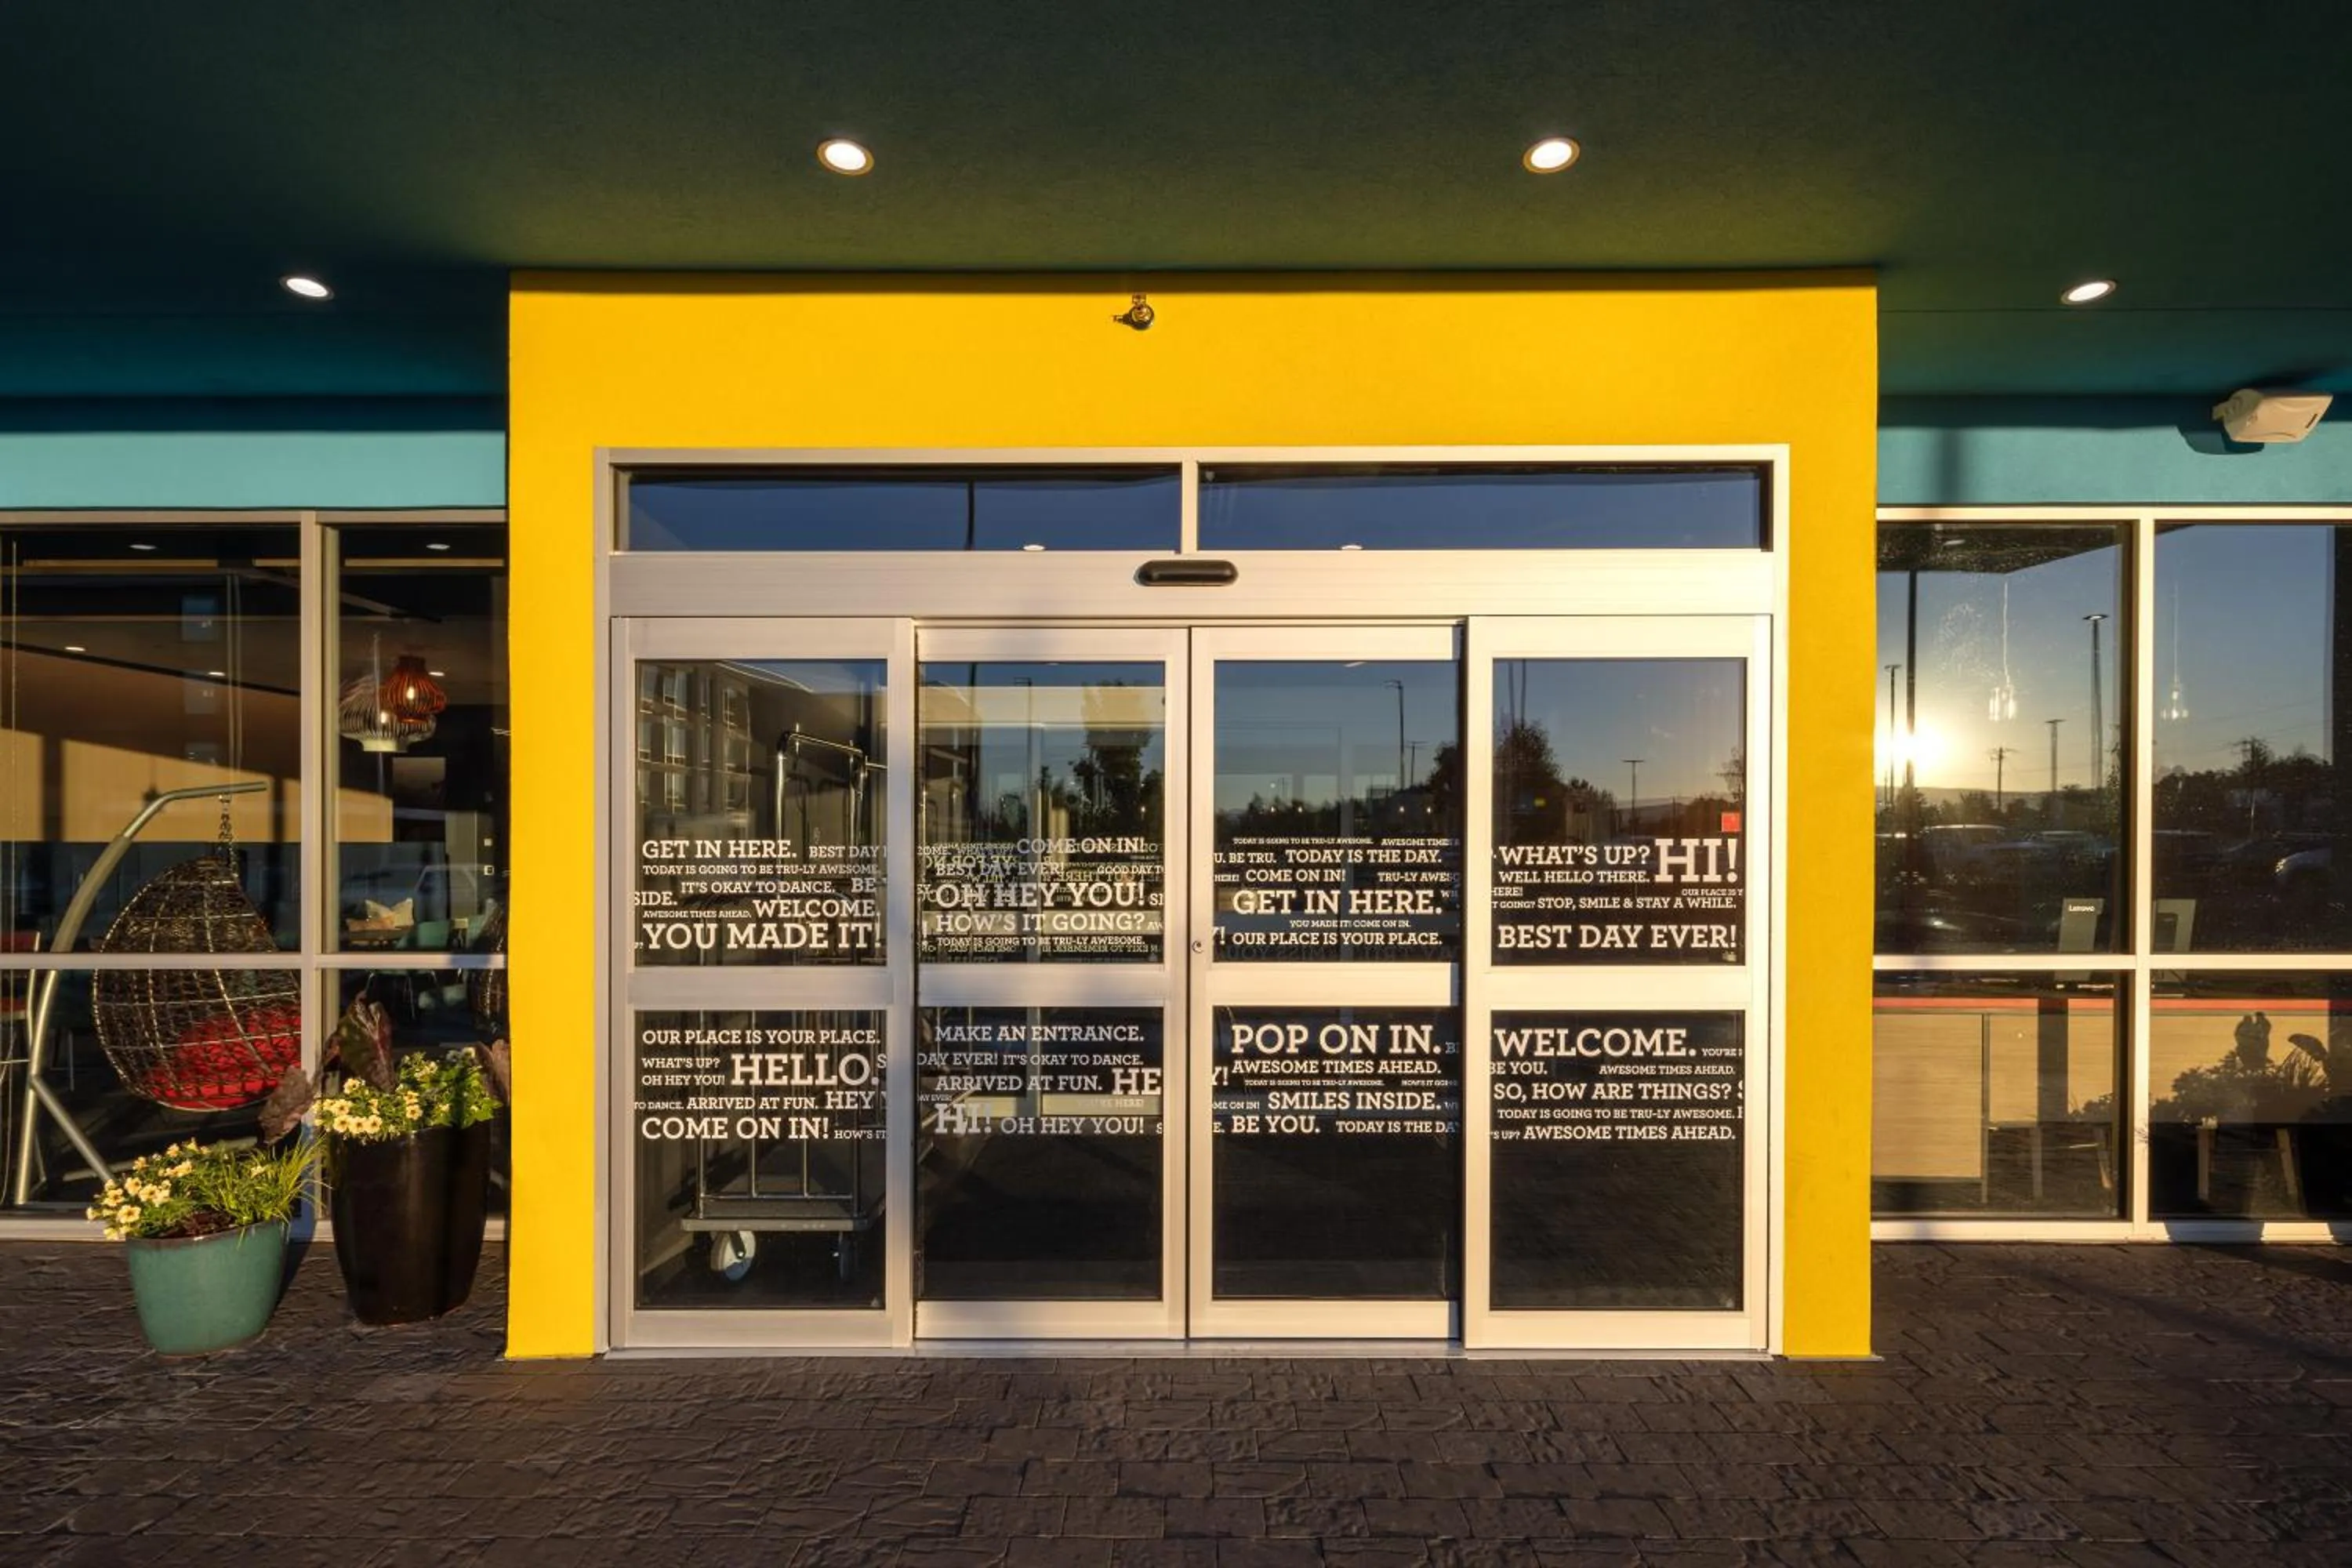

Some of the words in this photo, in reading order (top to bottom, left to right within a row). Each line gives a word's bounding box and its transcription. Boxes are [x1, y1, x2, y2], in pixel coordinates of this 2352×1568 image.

[642, 840, 689, 858] GET
[695, 840, 722, 858] IN
[728, 840, 797, 858] HERE.
[808, 846, 845, 858] BEST
[849, 846, 879, 858] DAY
[1017, 838, 1076, 853] COME
[1081, 838, 1112, 853] ON
[1116, 837, 1145, 853] IN!
[1229, 852, 1245, 863] BE
[1247, 852, 1277, 863] TRU.
[1285, 849, 1345, 863] TODAY
[1347, 849, 1363, 863] IS
[1367, 849, 1401, 863] THE
[1404, 849, 1442, 863] DAY.
[1498, 845, 1598, 866] WHAT'S
[1603, 845, 1650, 866] UP?
[1654, 838, 1738, 883] HI!
[643, 865, 684, 875] TODAY
[685, 865, 696, 875] IS
[699, 865, 738, 875] GOING
[740, 865, 757, 875] TO
[759, 865, 774, 875] BE
[775, 865, 817, 875] TRU-LY
[935, 863, 972, 876] BEST
[980, 862, 1012, 876] DAY
[1018, 862, 1064, 875] EVER!
[1131, 866, 1152, 874] DAY
[1246, 869, 1293, 882] COME
[1296, 869, 1320, 882] ON
[1323, 869, 1345, 882] IN!
[1377, 872, 1418, 882] TRU-LY
[1498, 871, 1541, 884] WELL
[1544, 871, 1594, 884] HELLO
[1596, 871, 1650, 884] THERE.
[681, 880, 708, 893] IT'S
[711, 880, 752, 893] OKAY
[755, 880, 777, 893] TO
[778, 880, 836, 893] DANCE.
[851, 877, 877, 893] BE
[935, 884, 985, 908] OH
[993, 882, 1060, 907] HEY
[1067, 882, 1145, 906] YOU!
[1232, 890, 1297, 915] GET
[1304, 890, 1341, 915] IN
[1348, 890, 1443, 915] HERE.
[753, 899, 881, 917] WELCOME.
[1537, 897, 1577, 911] STOP,
[1578, 897, 1621, 909] SMILE
[1623, 897, 1633, 909] &
[1636, 897, 1671, 909] STAY
[1673, 897, 1684, 909] A
[1686, 897, 1737, 909] WHILE.
[936, 914, 1016, 932] HOW'S
[1022, 913, 1046, 931] IT
[1052, 913, 1145, 931] GOING?
[642, 924, 718, 949] YOU
[727, 924, 829, 949] MADE
[838, 924, 881, 949] IT!
[984, 937, 1020, 946] GOING
[1021, 937, 1036, 946] TO
[1051, 936, 1089, 945] TRU-LY
[1091, 936, 1145, 945] AWESOME.
[1232, 932, 1266, 945] OUR
[1269, 932, 1319, 945] PLACE
[1323, 932, 1338, 945] IS
[1341, 932, 1385, 945] YOUR
[1388, 932, 1443, 945] PLACE.
[1497, 924, 1572, 948] BEST
[1579, 924, 1643, 948] DAY
[1650, 924, 1737, 948] EVER!
[642, 1029, 681, 1044] OUR
[684, 1029, 742, 1044] PLACE
[745, 1029, 762, 1044] IS
[765, 1029, 816, 1044] YOUR
[819, 1029, 880, 1044] PLACE.
[935, 1025, 992, 1041] MAKE
[996, 1025, 1026, 1041] AN
[1031, 1025, 1145, 1041] ENTRANCE.
[1231, 1024, 1308, 1054] POP
[1319, 1024, 1380, 1054] ON
[1388, 1024, 1441, 1054] IN.
[1494, 1028, 1697, 1057] WELCOME.
[641, 1058, 693, 1069] WHAT'S
[695, 1058, 720, 1069] UP?
[916, 1053, 949, 1065] DAY
[953, 1053, 998, 1065] EVER!
[1003, 1054, 1028, 1065] IT'S
[1029, 1054, 1069, 1065] OKAY
[1070, 1054, 1089, 1065] TO
[1092, 1054, 1144, 1065] DANCE.
[730, 1053, 879, 1086] HELLO.
[1231, 1061, 1319, 1073] AWESOME
[1323, 1061, 1374, 1073] TIMES
[1377, 1061, 1442, 1073] AHEAD.
[1599, 1065, 1656, 1075] AWESOME
[1658, 1065, 1693, 1075] TIMES
[1694, 1065, 1736, 1075] AHEAD.
[641, 1075, 663, 1086] OH
[665, 1075, 691, 1086] HEY
[693, 1075, 725, 1086] YOU!
[935, 1075, 1023, 1091] ARRIVED
[1027, 1075, 1054, 1091] AT
[1057, 1075, 1103, 1091] FUN.
[825, 1091, 875, 1109] HEY
[1268, 1091, 1351, 1110] SMILES
[1356, 1091, 1442, 1110] INSIDE.
[1494, 1083, 1527, 1103] SO,
[1531, 1083, 1588, 1100] HOW
[1592, 1083, 1633, 1100] ARE
[1638, 1083, 1732, 1100] THINGS?
[686, 1097, 757, 1109] ARRIVED
[759, 1097, 780, 1109] AT
[782, 1097, 818, 1109] FUN.
[935, 1103, 992, 1134] HI!
[1497, 1109, 1537, 1119] TODAY
[1539, 1109, 1551, 1119] IS
[1552, 1109, 1592, 1119] GOING
[1594, 1109, 1611, 1119] TO
[1613, 1109, 1628, 1119] BE
[1629, 1109, 1671, 1119] TRU-LY
[1672, 1109, 1735, 1119] AWESOME.
[641, 1116, 728, 1139] COME
[736, 1116, 782, 1139] ON
[788, 1116, 829, 1139] IN!
[1000, 1116, 1036, 1134] OH
[1040, 1116, 1086, 1134] HEY
[1091, 1116, 1144, 1134] YOU!
[1232, 1115, 1260, 1133] BE
[1265, 1115, 1321, 1133] YOU.
[1336, 1120, 1385, 1133] TODAY
[1388, 1120, 1401, 1133] IS
[1403, 1120, 1433, 1133] THE
[1523, 1125, 1611, 1139] AWESOME
[1614, 1125, 1668, 1139] TIMES
[1671, 1125, 1736, 1139] AHEAD.
